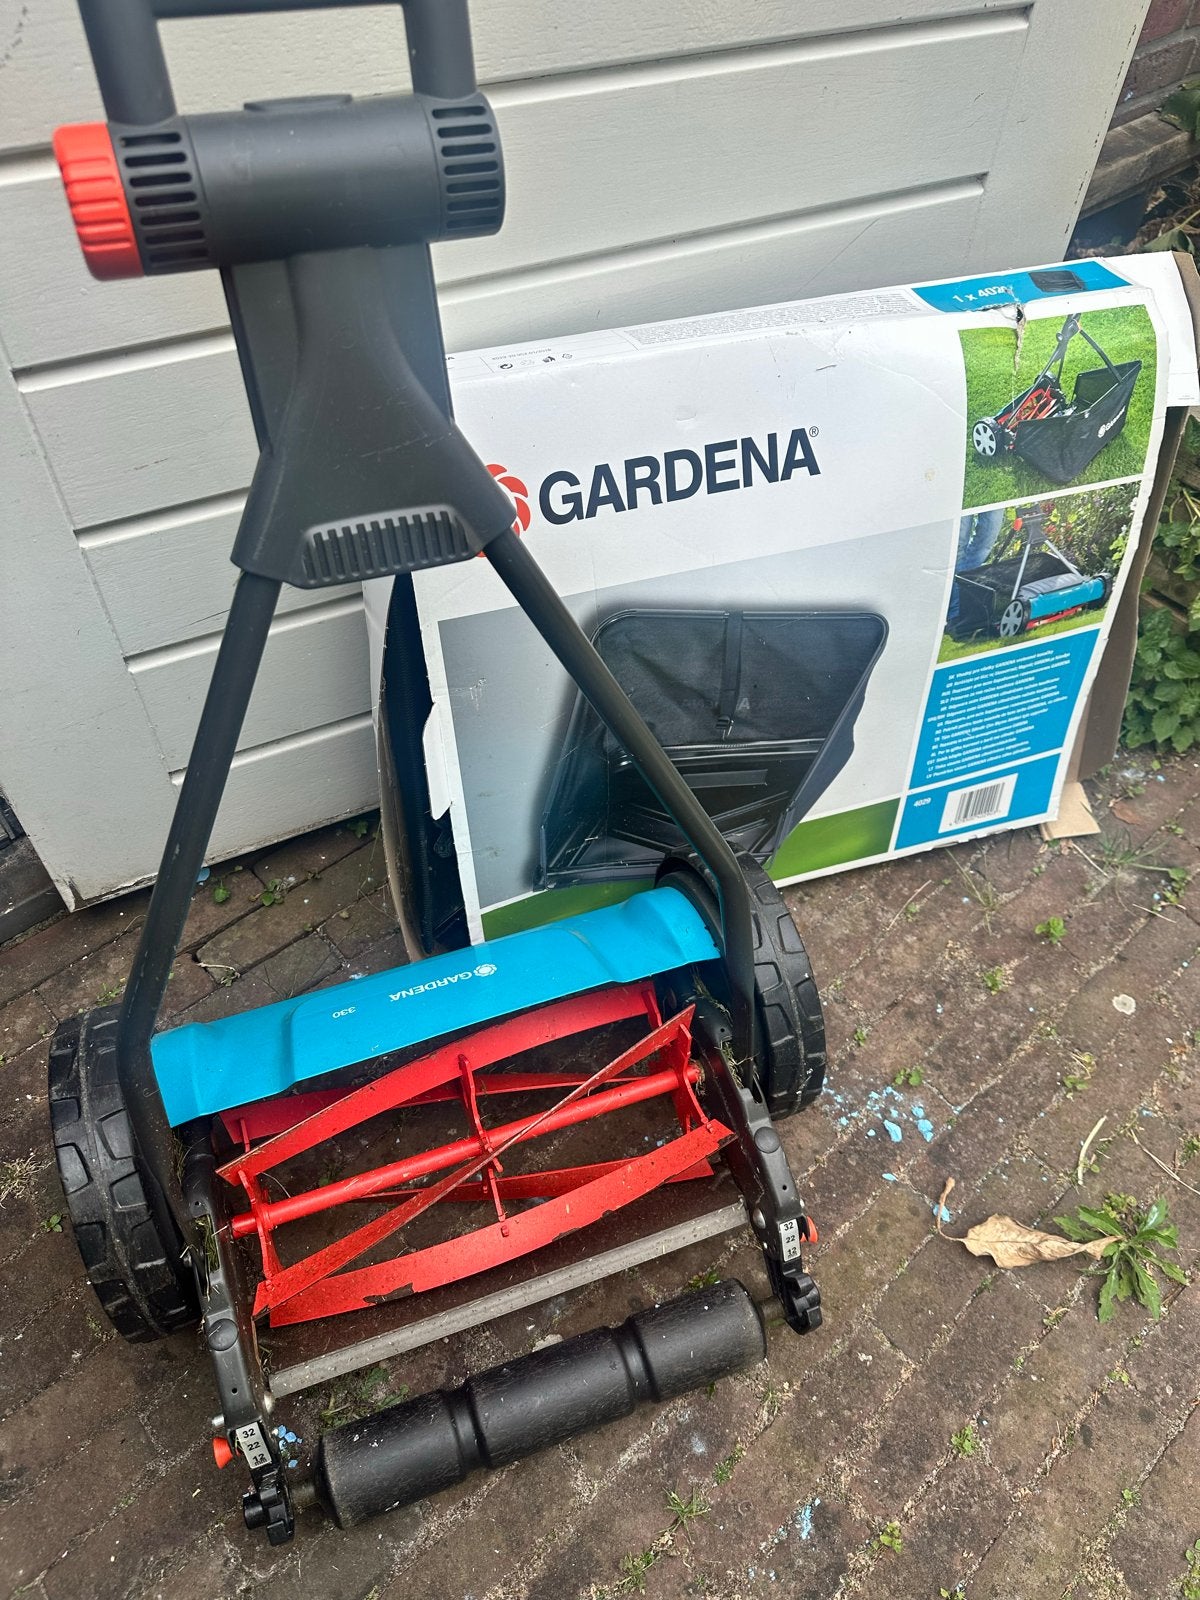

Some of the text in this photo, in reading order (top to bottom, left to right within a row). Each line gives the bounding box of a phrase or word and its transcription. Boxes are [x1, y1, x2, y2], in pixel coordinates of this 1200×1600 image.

[952, 294, 964, 303] 1
[913, 796, 932, 808] 4029
[389, 971, 473, 1001] GARDENA
[332, 1006, 356, 1019] 330
[784, 1222, 794, 1231] 32
[786, 1235, 795, 1243] 22
[787, 1247, 797, 1256] 12
[243, 1428, 256, 1438] 32
[247, 1442, 260, 1451] 22
[253, 1453, 264, 1463] 12
